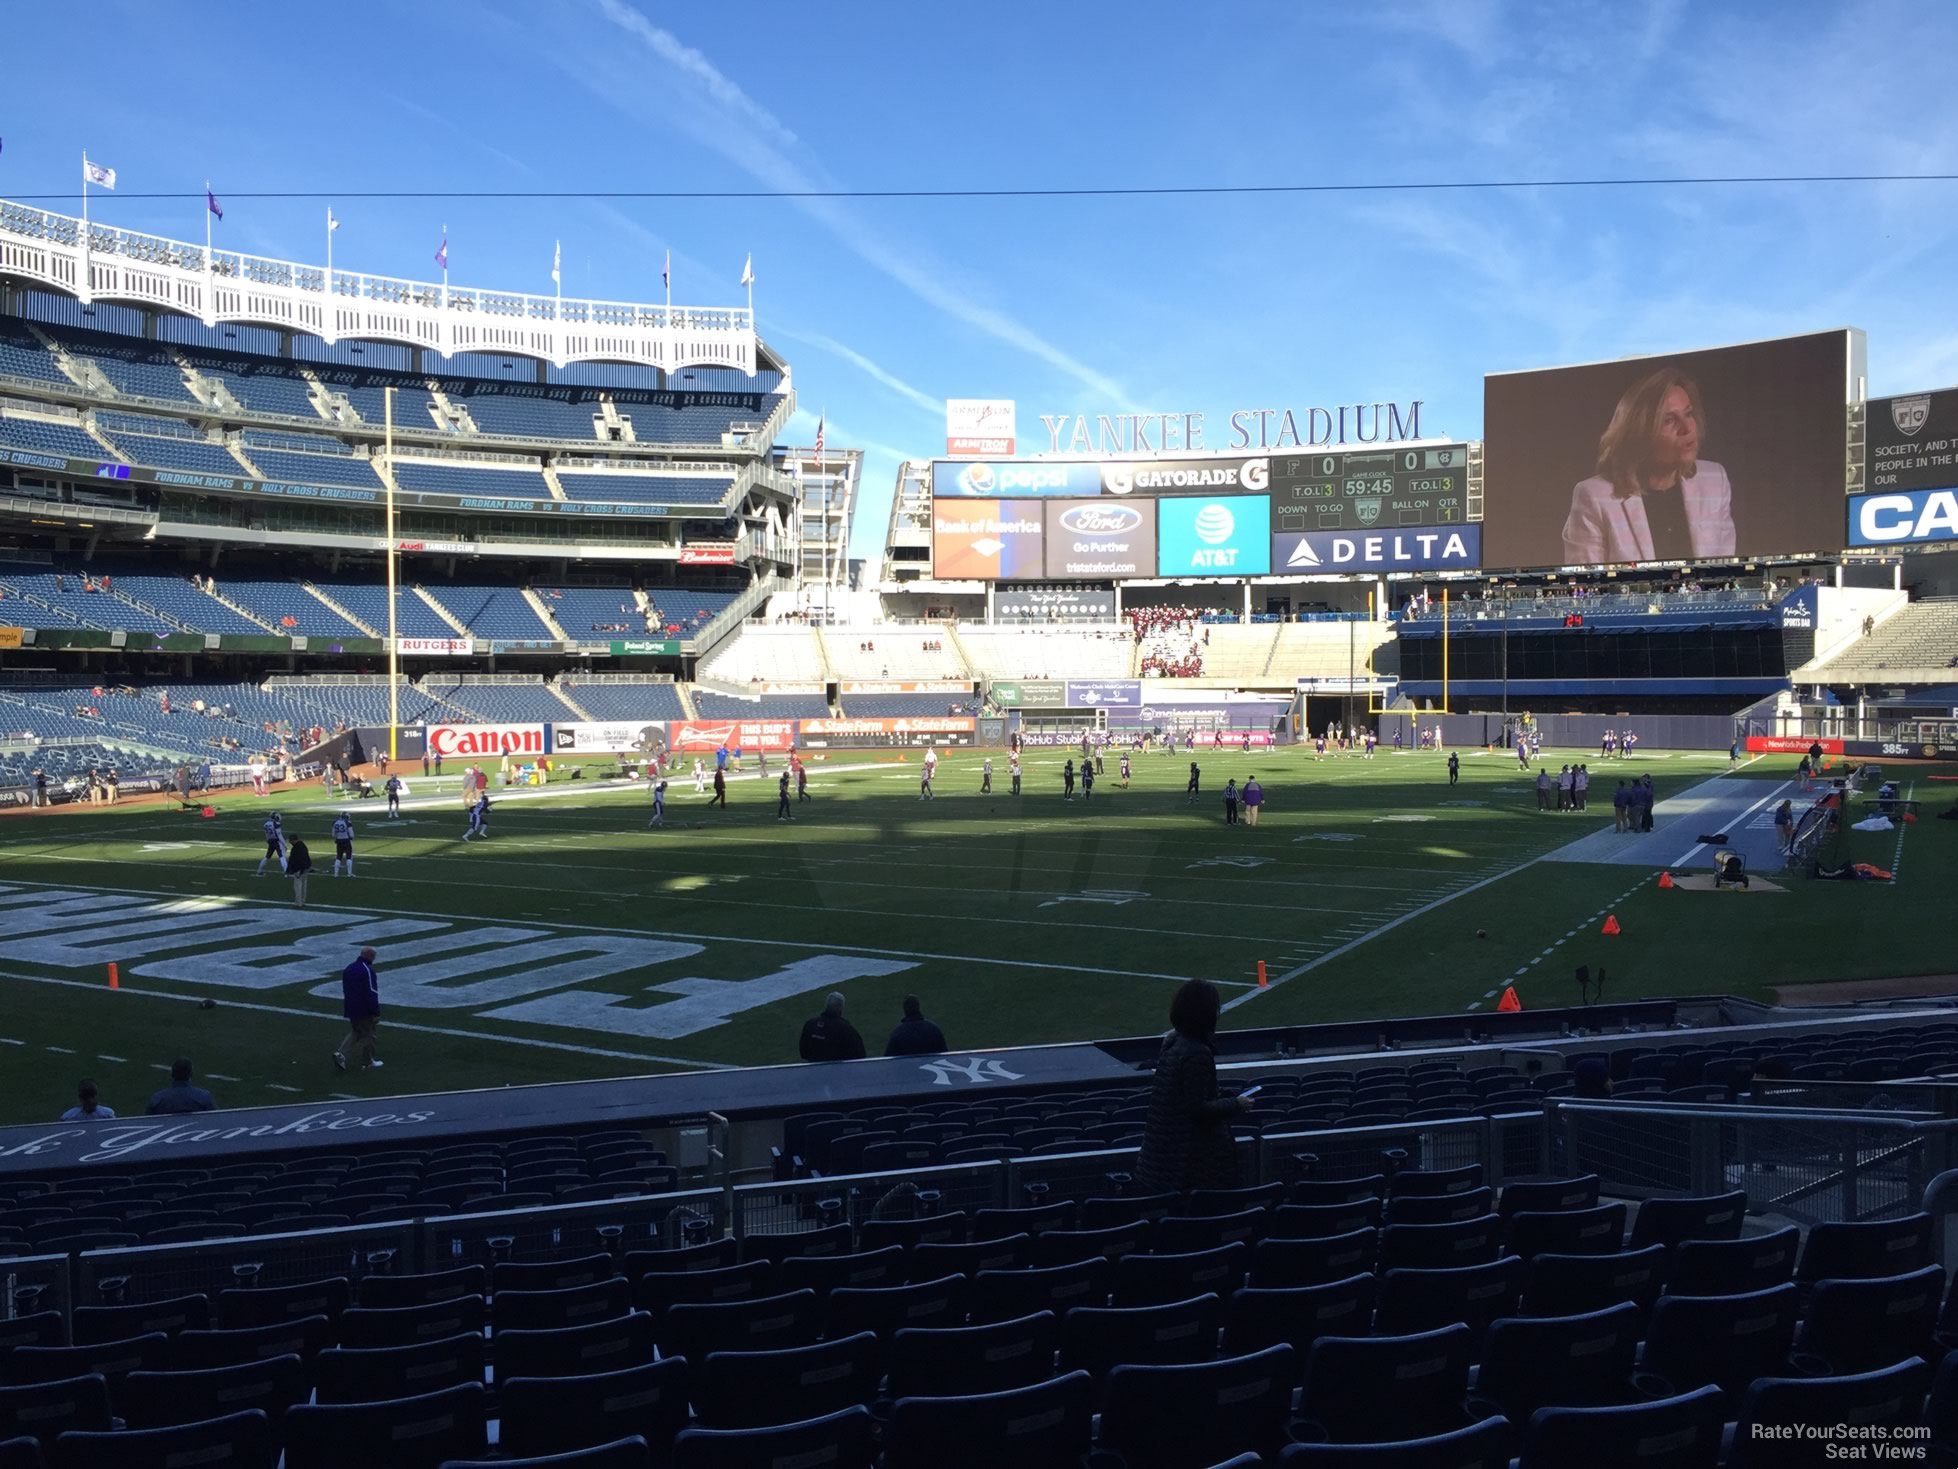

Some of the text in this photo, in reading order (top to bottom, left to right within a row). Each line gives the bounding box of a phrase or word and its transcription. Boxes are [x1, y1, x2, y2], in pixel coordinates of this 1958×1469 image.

[1040, 401, 1425, 453] YANKEE STADIUM
[1875, 442, 1922, 457] SOCIETY,
[1925, 440, 1948, 451] AND
[11, 452, 68, 470] CRUSADERS
[1322, 457, 1336, 475] 0
[1404, 452, 1418, 470] 0
[1875, 459, 1913, 471] PEOPLE
[1916, 457, 1929, 468] IN
[1931, 454, 1953, 466] THE
[1001, 465, 1068, 492] pepsi
[1136, 468, 1240, 488] GATORADE
[1352, 471, 1369, 479] GAME
[1874, 474, 1898, 486] OUR
[155, 471, 203, 487] FORDHAM
[203, 476, 234, 489] RAMS
[261, 482, 285, 493] HOLY
[286, 484, 318, 496] CROSS
[319, 486, 376, 500] CRUSADERS
[1324, 484, 1333, 496] 3
[1345, 479, 1393, 495] 59:45
[1441, 478, 1451, 489] 3
[459, 499, 505, 510] FORDHAM
[506, 501, 534, 511] RAMS
[560, 503, 583, 512] HOLY
[584, 504, 613, 513] CROSS
[614, 504, 668, 515] CRUSADERS
[1278, 503, 1344, 514] DOWN TO GO
[1393, 499, 1429, 510] BALL ON
[1439, 498, 1458, 507] QTR
[936, 520, 971, 534] Bank
[986, 520, 1041, 534] America
[1077, 511, 1125, 532] Ford
[399, 542, 423, 550] Audi
[1073, 542, 1130, 554] Go Further
[1332, 533, 1468, 563] DELTA
[1190, 549, 1238, 568] AT&T
[1783, 617, 1800, 627] SPORTS
[403, 640, 467, 649] RUTGERS
[740, 723, 791, 735] THIS BUD'S
[825, 720, 969, 731] State Farm State Farm
[431, 728, 542, 755] Canon
[740, 735, 759, 746] FOR
[79, 1109, 436, 1161] Yankees
